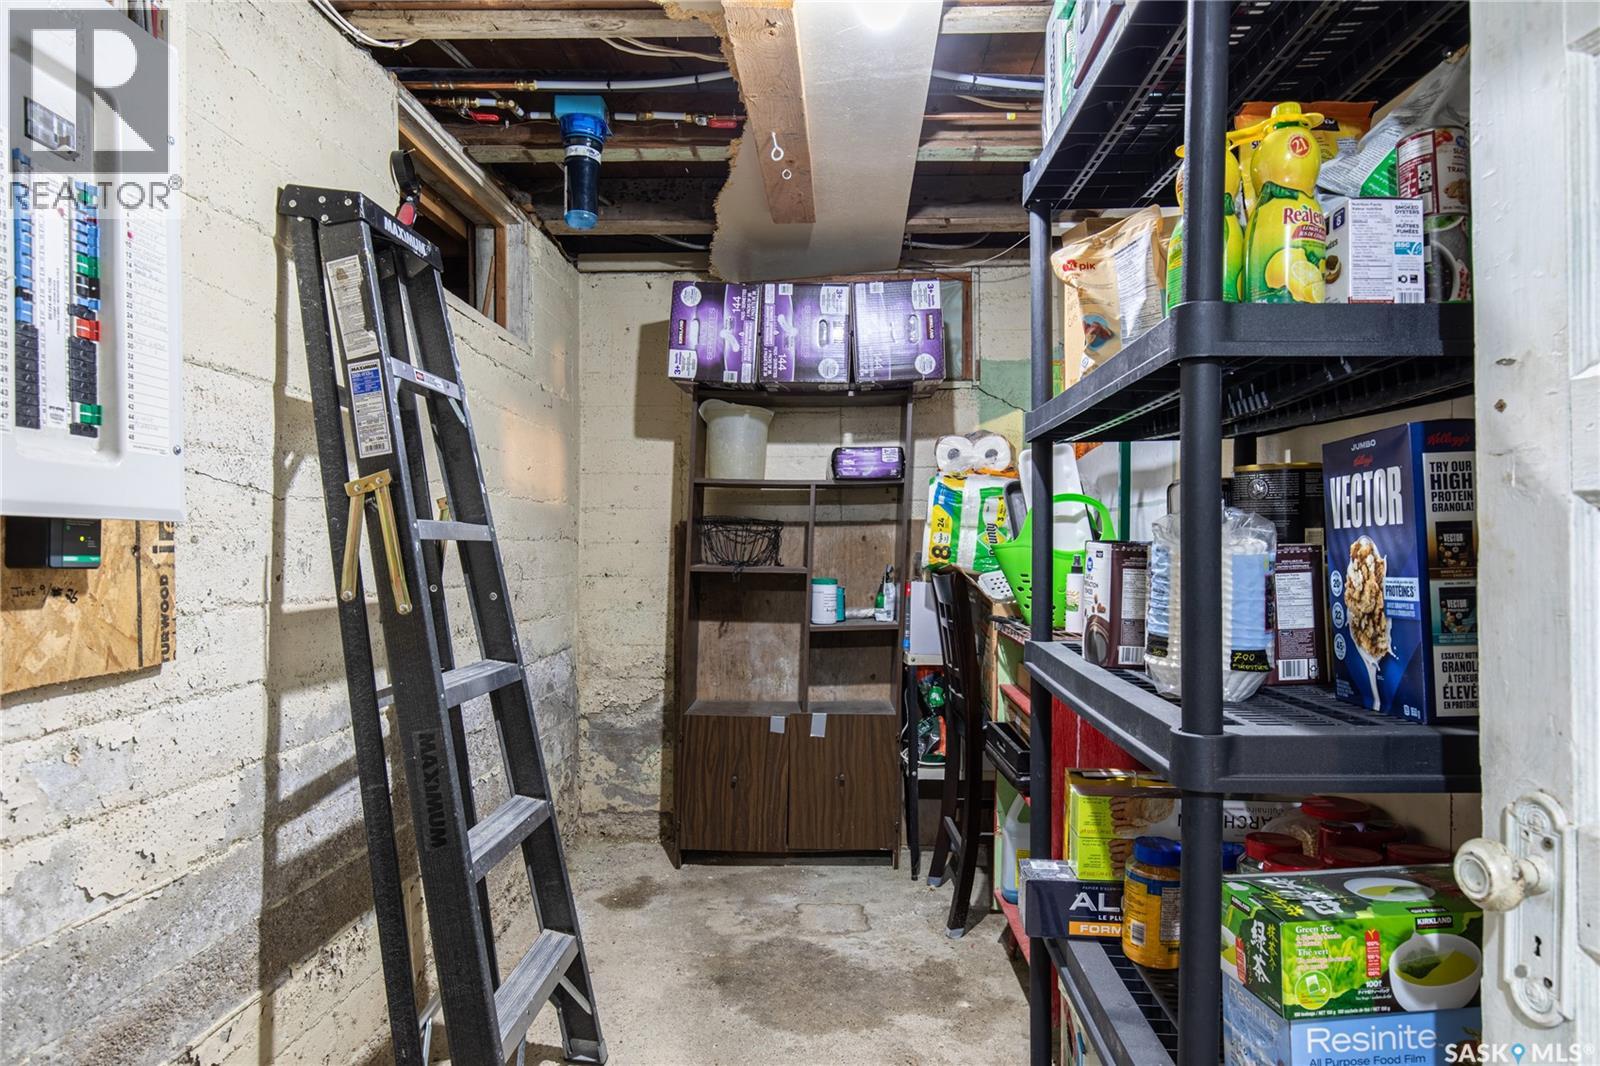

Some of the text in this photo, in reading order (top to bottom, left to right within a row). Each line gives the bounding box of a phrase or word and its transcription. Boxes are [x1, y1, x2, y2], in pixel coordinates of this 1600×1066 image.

[1292, 138, 1308, 153] 21
[732, 296, 741, 312] 144
[778, 354, 787, 371] 144
[1351, 439, 1376, 451] JUMBO
[1430, 460, 1472, 472] TRY OUR
[1431, 473, 1472, 490] HIGH
[1330, 465, 1404, 530] VECTOR
[1432, 490, 1473, 502] PROTEIN
[1443, 533, 1464, 542] VECTOR
[932, 546, 952, 560] 8
[1446, 599, 1468, 608] VECTOR
[1335, 610, 1342, 619] 22
[1417, 917, 1452, 925] KIRKLAND
[1306, 1027, 1436, 1054] Resinite
[1310, 1054, 1426, 1066] All Purpose Food Film
